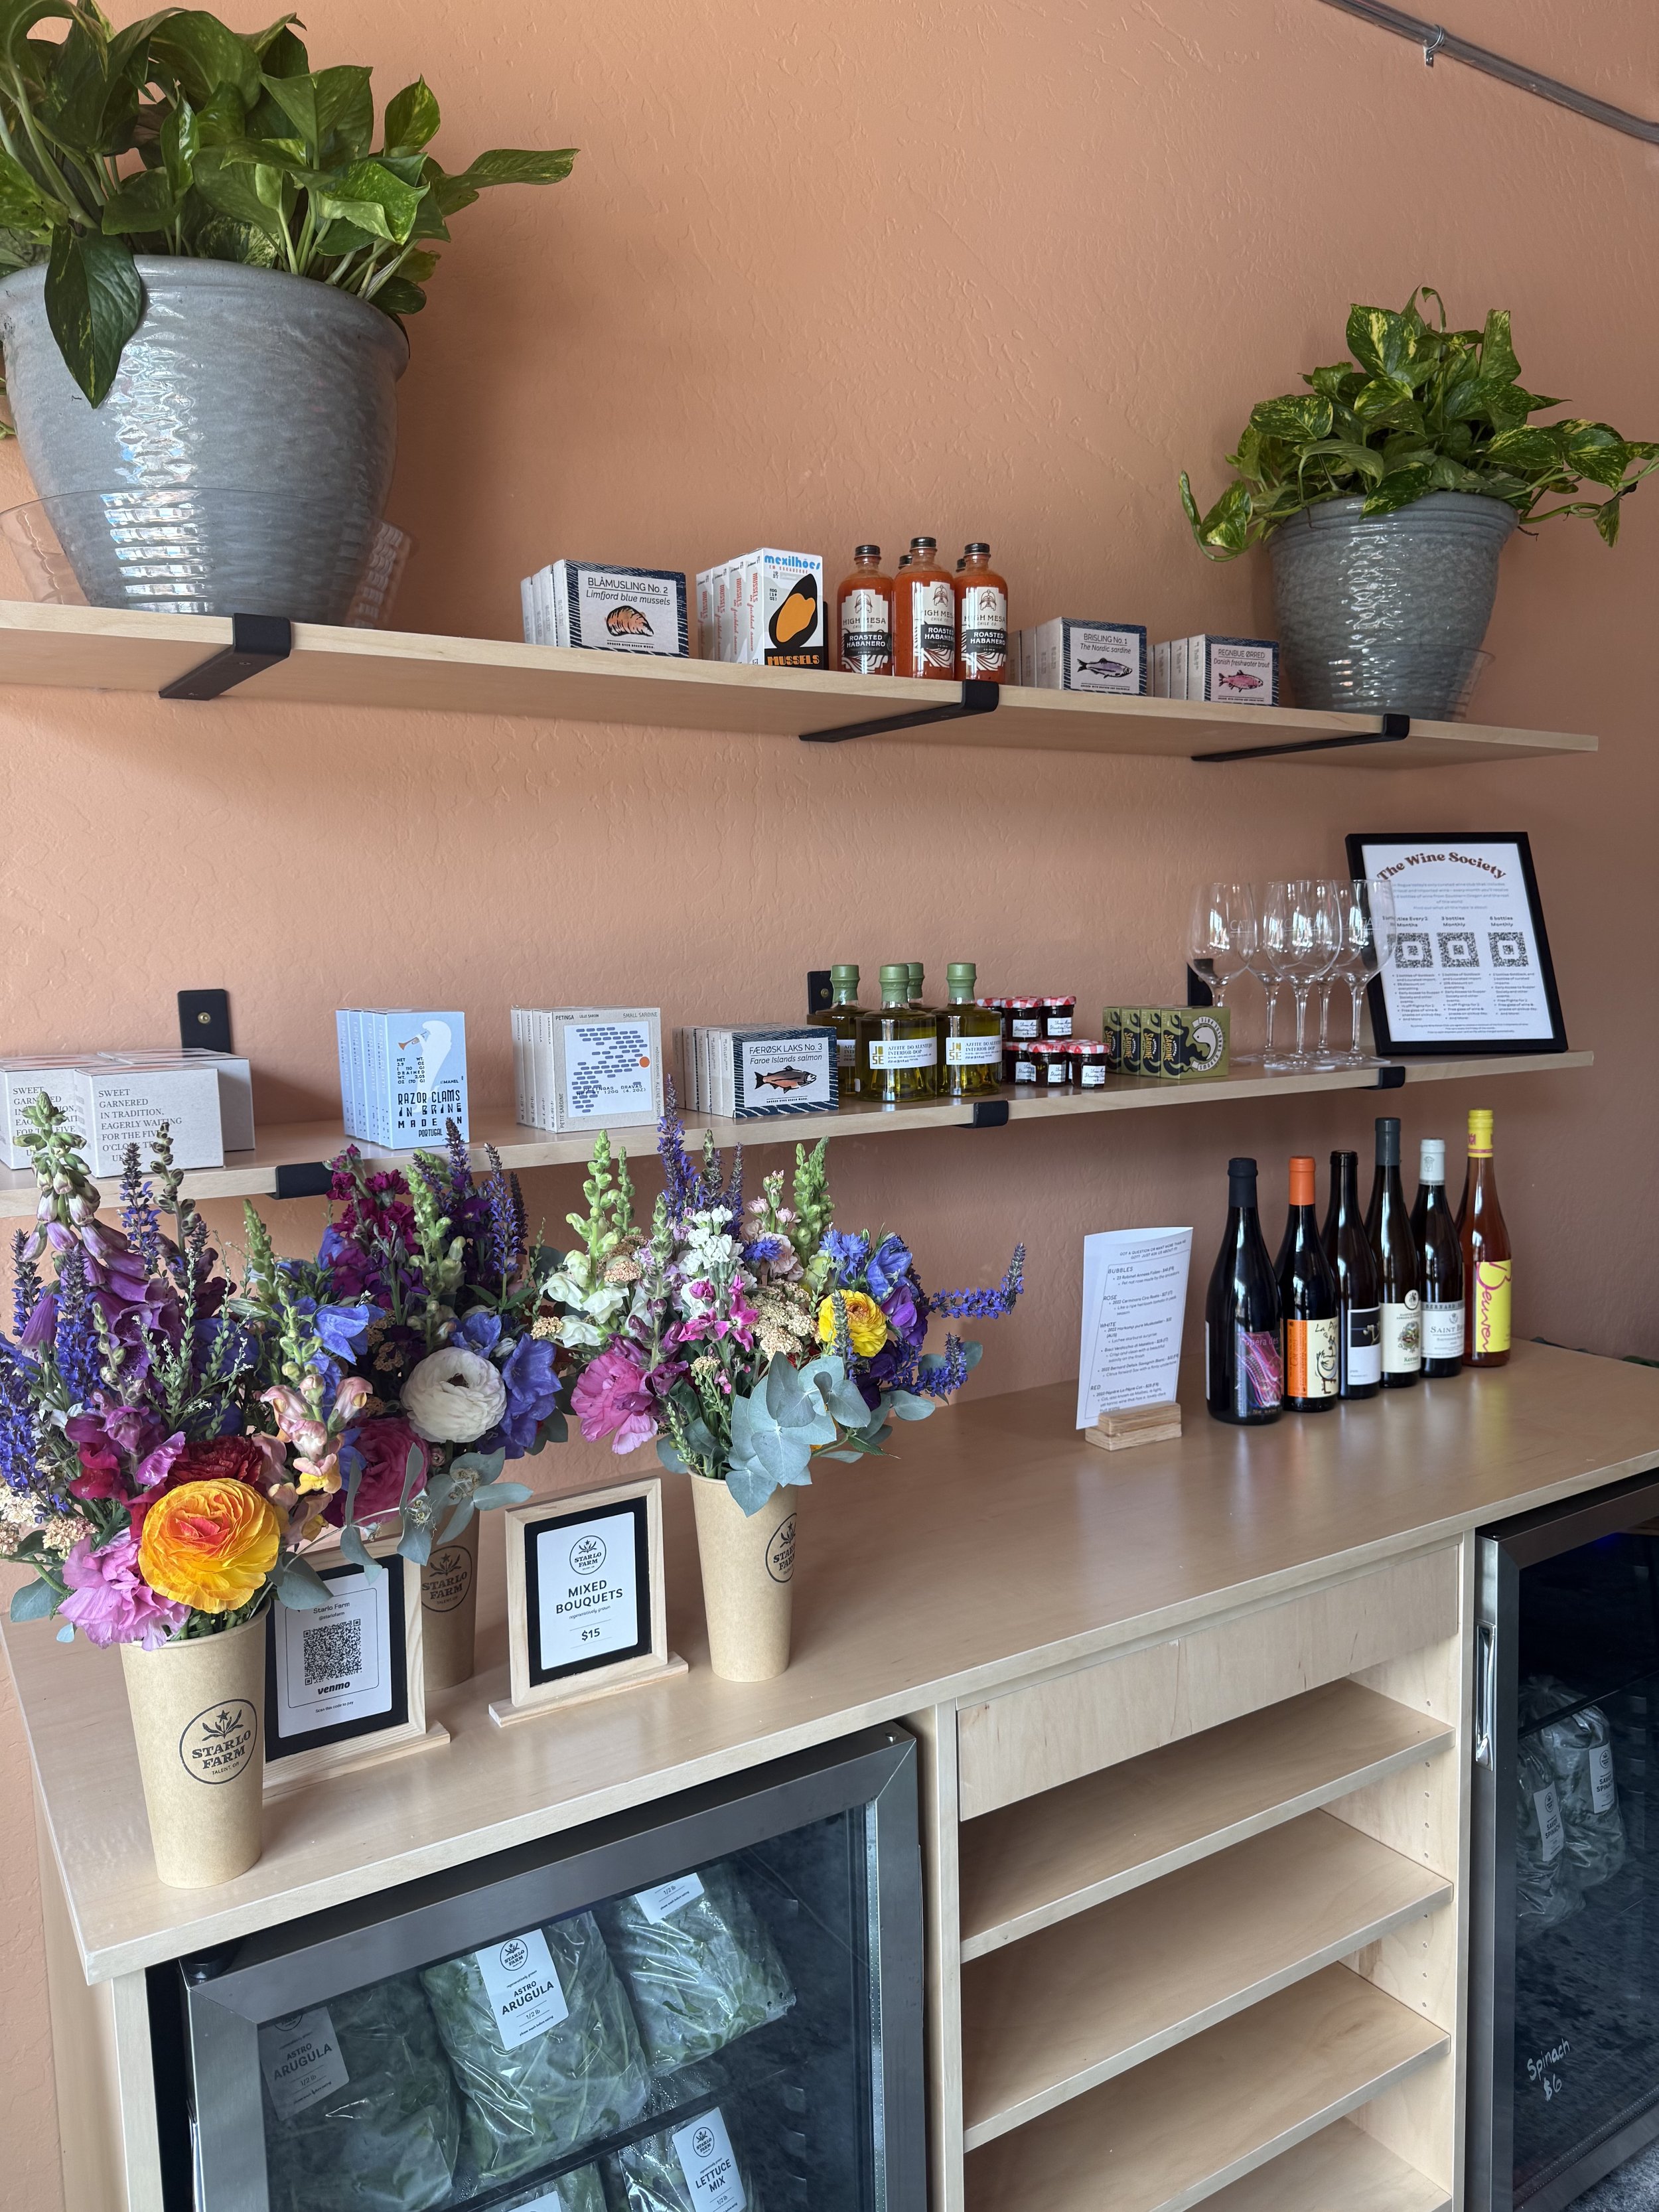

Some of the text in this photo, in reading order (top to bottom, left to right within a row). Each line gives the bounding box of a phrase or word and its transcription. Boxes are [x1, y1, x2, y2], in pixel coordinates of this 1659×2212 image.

[764, 555, 820, 570] mexilhões
[586, 590, 618, 601] Limfjord
[639, 596, 670, 605] mussels
[1084, 633, 1112, 643] BRISLING
[1091, 644, 1110, 654] Nordic
[1218, 649, 1265, 659] REGNBUE ØRRED
[767, 654, 820, 666] MUSSELS
[1230, 659, 1257, 668] freshwater
[1377, 852, 1506, 881] The Wine Society
[1124, 1033, 1133, 1059] SARDINE
[1143, 1033, 1154, 1059] SARDINE
[1164, 1035, 1174, 1061] SARDINE
[100, 1099, 148, 1108] GARNERED
[398, 1090, 460, 1105] RAZOR CLAMS
[399, 1103, 461, 1116] IN BRINE
[102, 1121, 141, 1130] EAGERLY
[398, 1118, 437, 1128] MADE
[419, 1128, 443, 1137] PORTUGAL
[575, 1552, 602, 1563] STARLO
[579, 1559, 598, 1568] FARM
[421, 1572, 467, 1590] STARLO
[568, 1580, 607, 1597] MIXED
[430, 1584, 463, 1600] FARM
[313, 1601, 350, 1614] Starlo Farm
[556, 1588, 623, 1614] BOUQUETS
[582, 1628, 601, 1641] $15
[318, 1681, 350, 1695] venmo
[192, 1730, 251, 1759] STARLO
[202, 1745, 246, 1769] FARM
[212, 1765, 231, 1775] TALENT,
[504, 1949, 524, 1964] STARLO
[508, 1955, 524, 1966] FARM
[514, 1980, 536, 1997] ASTRO
[502, 1981, 554, 2015] ARUGULA
[287, 2043, 312, 2061] ASTRO
[1527, 2037, 1570, 2081] Spinach
[274, 2043, 332, 2081] ARUGULA
[1544, 2073, 1561, 2101] $6
[697, 2138, 712, 2150] STARLO
[700, 2144, 711, 2152] FARM
[695, 2159, 731, 2189] LETTUCE
[709, 2175, 725, 2192] MIX
